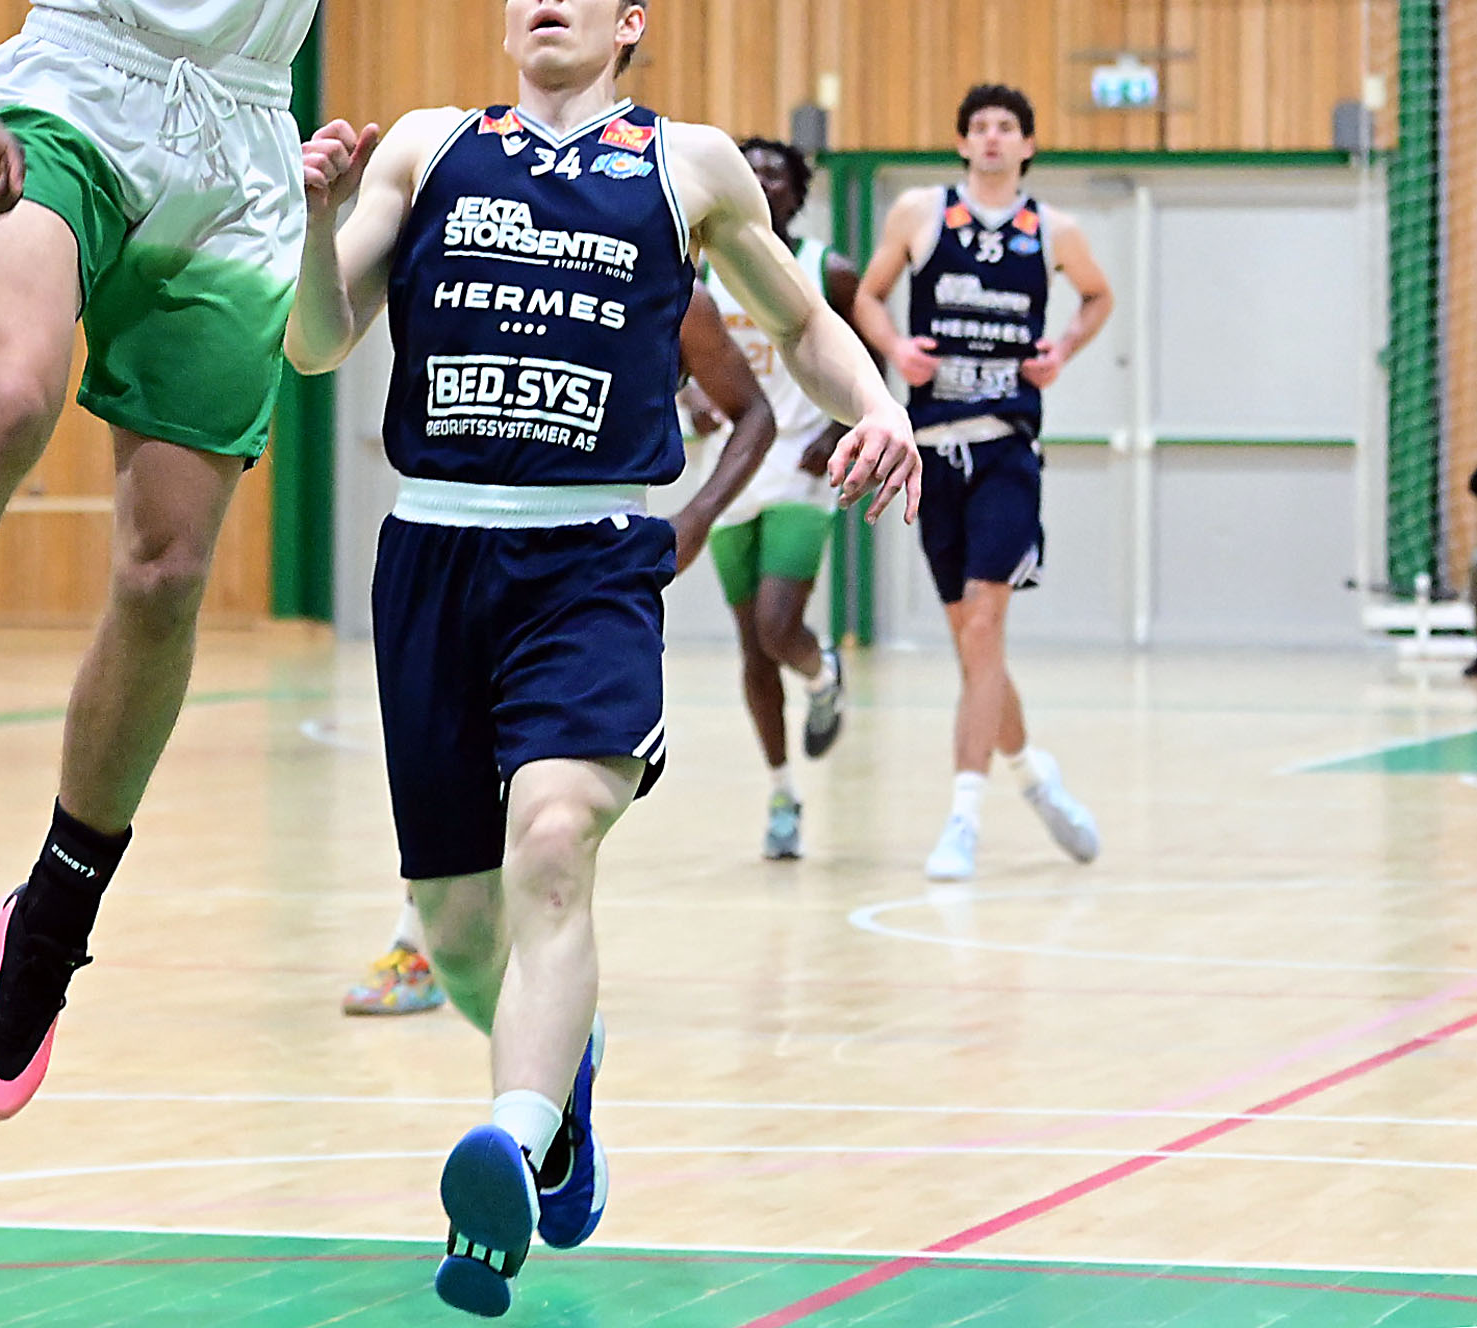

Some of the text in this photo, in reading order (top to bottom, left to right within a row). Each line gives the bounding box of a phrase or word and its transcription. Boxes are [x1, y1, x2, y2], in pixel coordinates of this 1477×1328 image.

[530, 147, 582, 180] 34
[446, 196, 533, 228] JEKTA
[443, 219, 639, 271] STORSENTER
[605, 265, 634, 283] NORD
[433, 281, 626, 330] HERMES
[930, 318, 1032, 344] HERMES
[436, 366, 597, 418] BED.SYS.
[425, 418, 597, 453] BEDRIFTSSYSTEMER AS
